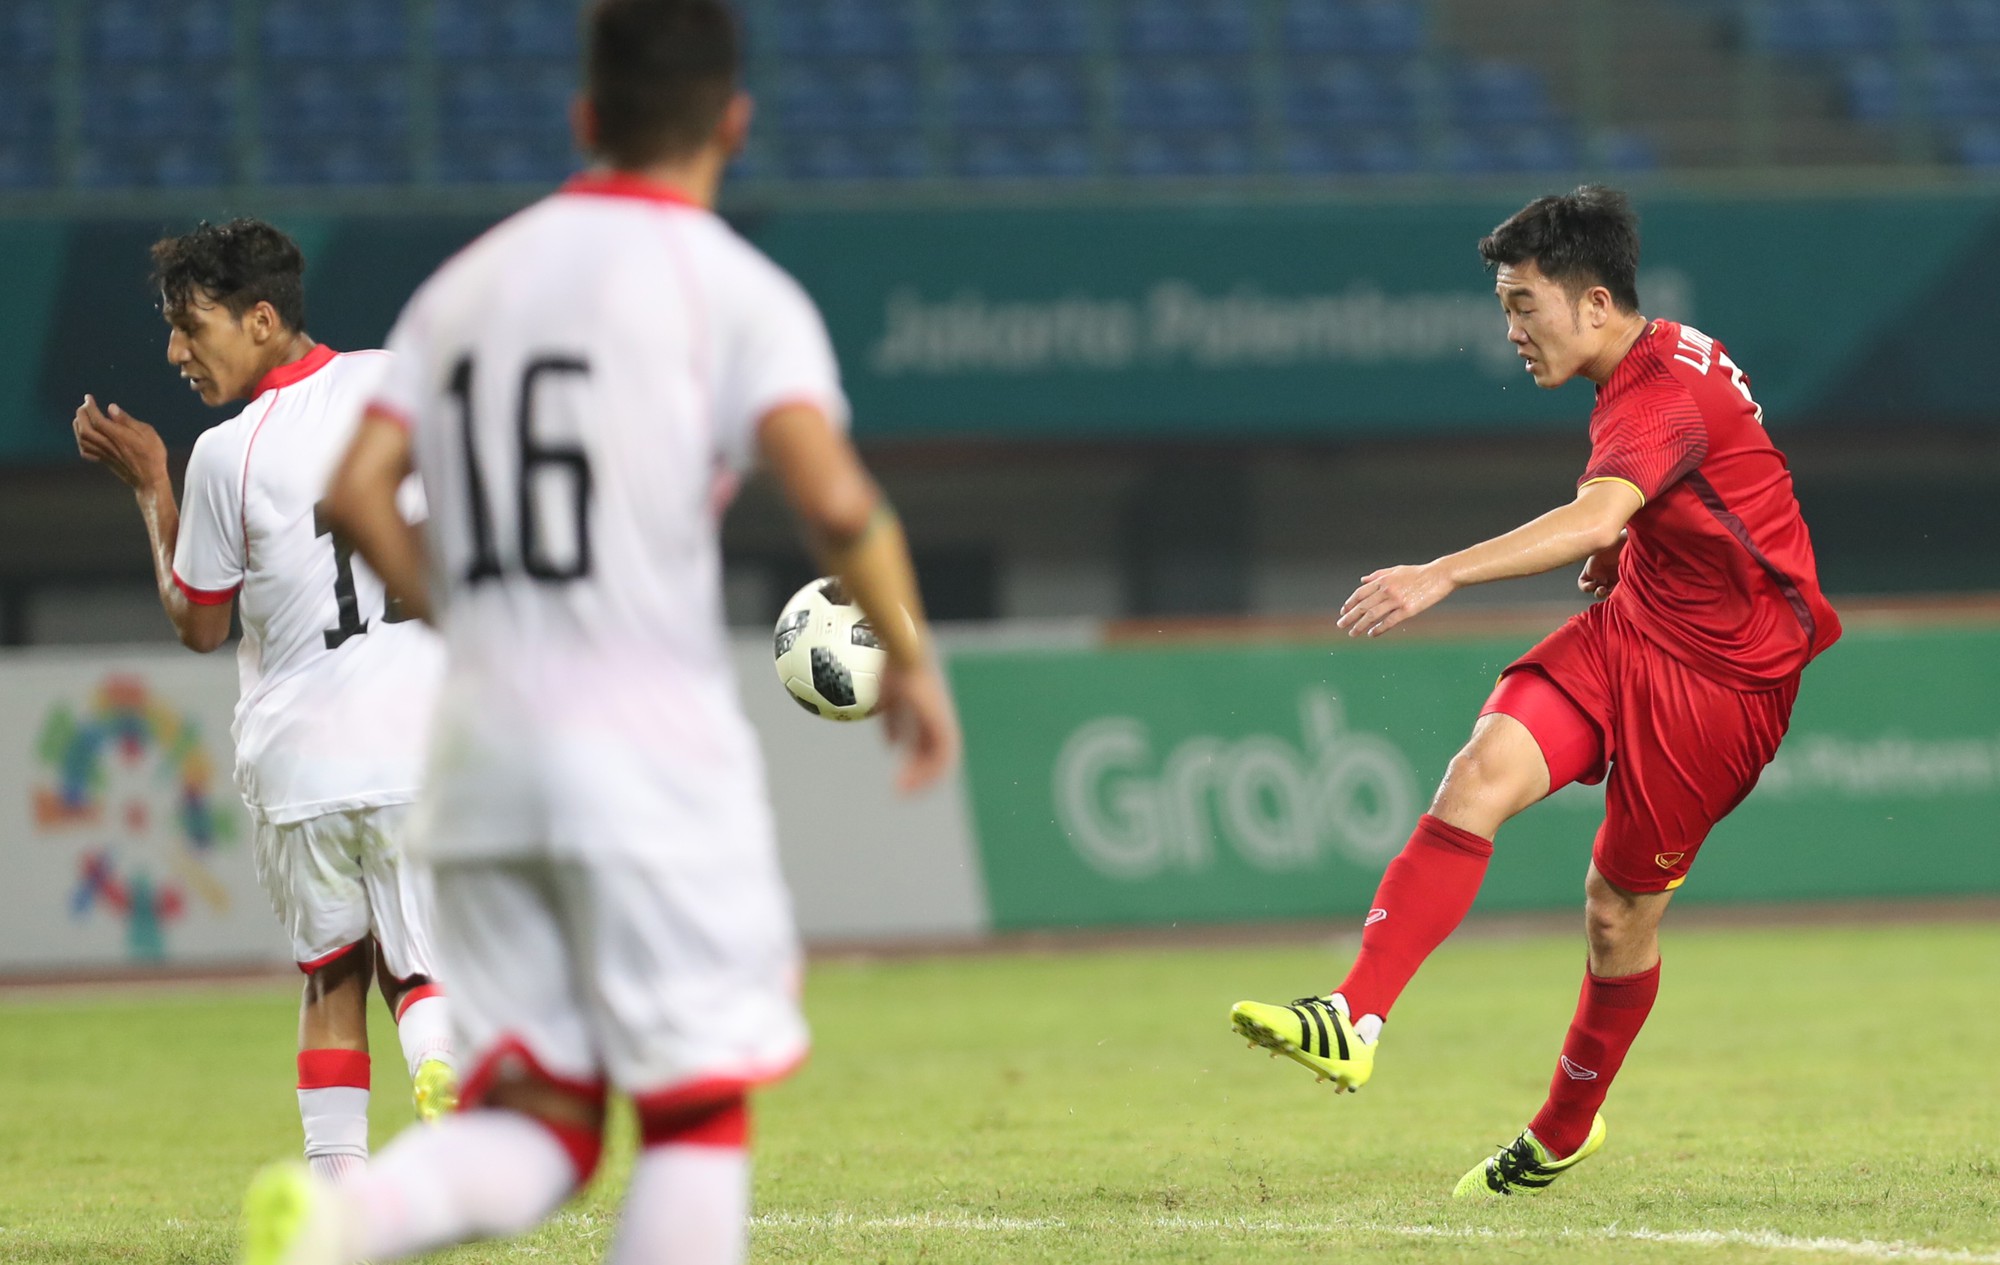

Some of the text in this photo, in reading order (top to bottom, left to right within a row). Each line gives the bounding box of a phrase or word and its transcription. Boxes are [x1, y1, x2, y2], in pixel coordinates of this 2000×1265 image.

[446, 353, 591, 583] 16
[313, 499, 428, 650] 1
[1053, 688, 1420, 880] Grab
